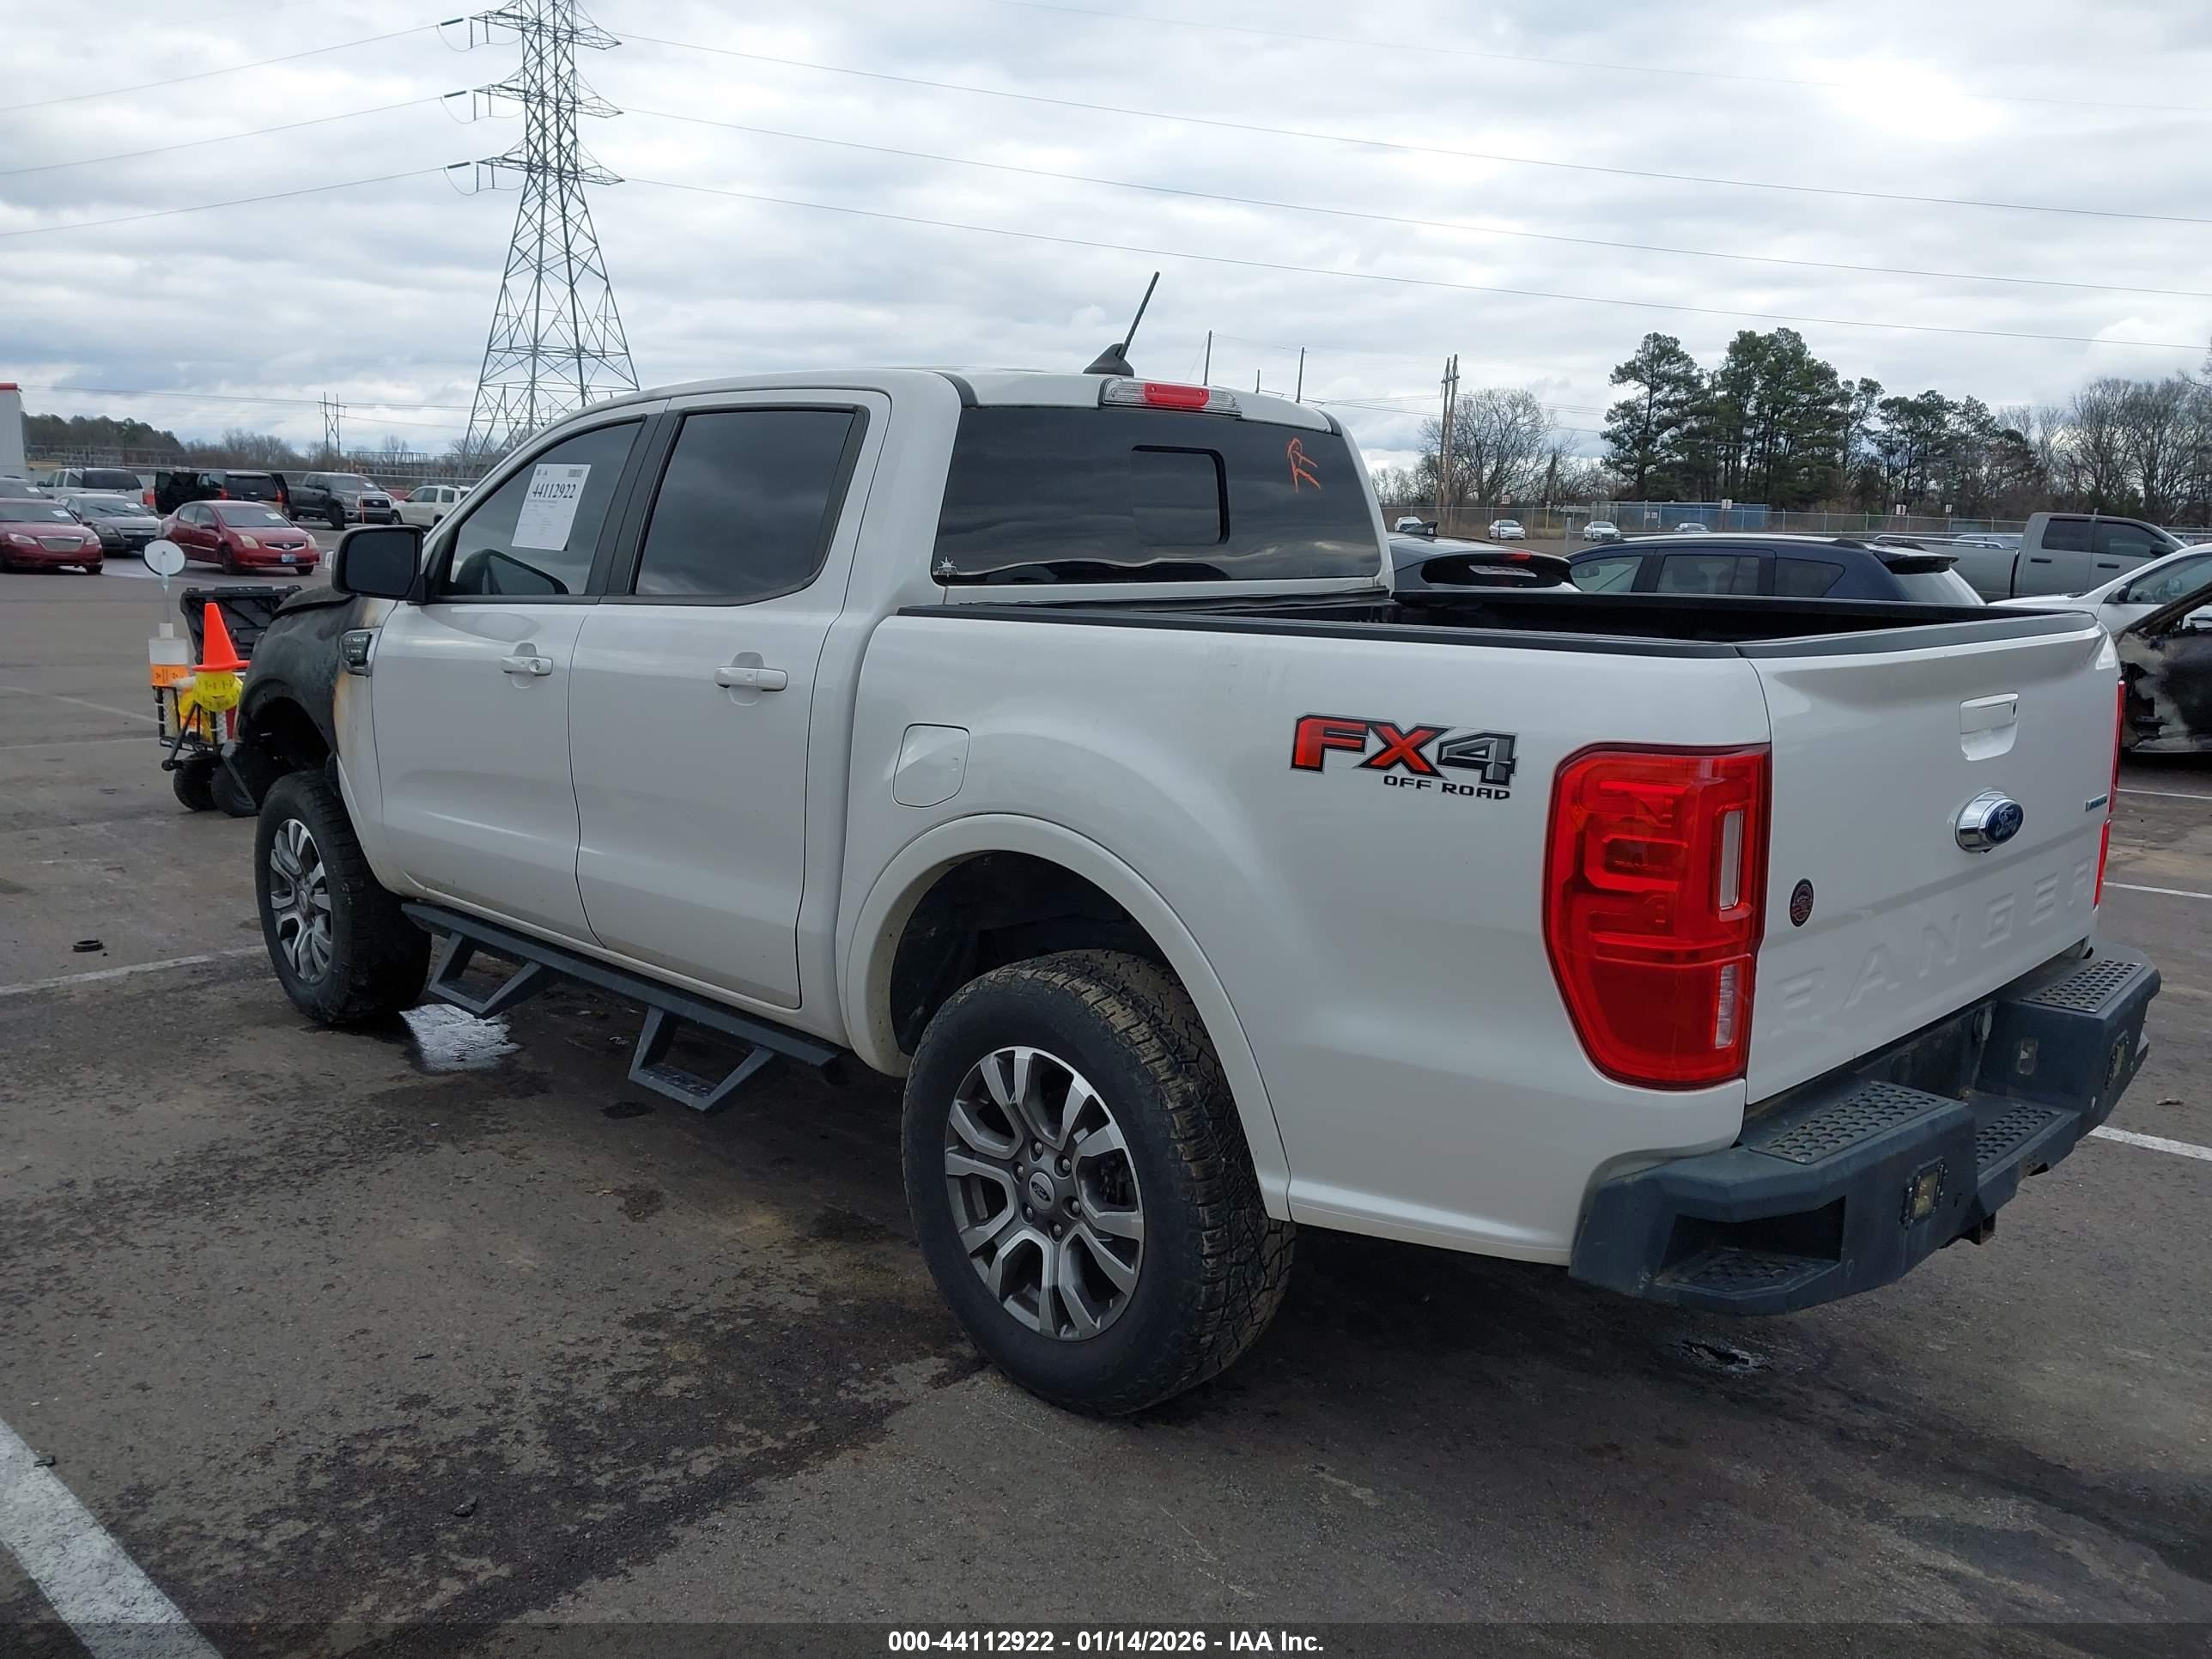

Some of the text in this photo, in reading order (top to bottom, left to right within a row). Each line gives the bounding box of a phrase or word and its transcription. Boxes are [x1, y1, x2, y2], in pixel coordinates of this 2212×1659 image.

[532, 483, 577, 498] 44112922
[1291, 713, 1518, 785] FX4
[1383, 775, 1510, 800] OFF ROAD
[1770, 856, 2095, 1036] RANGER
